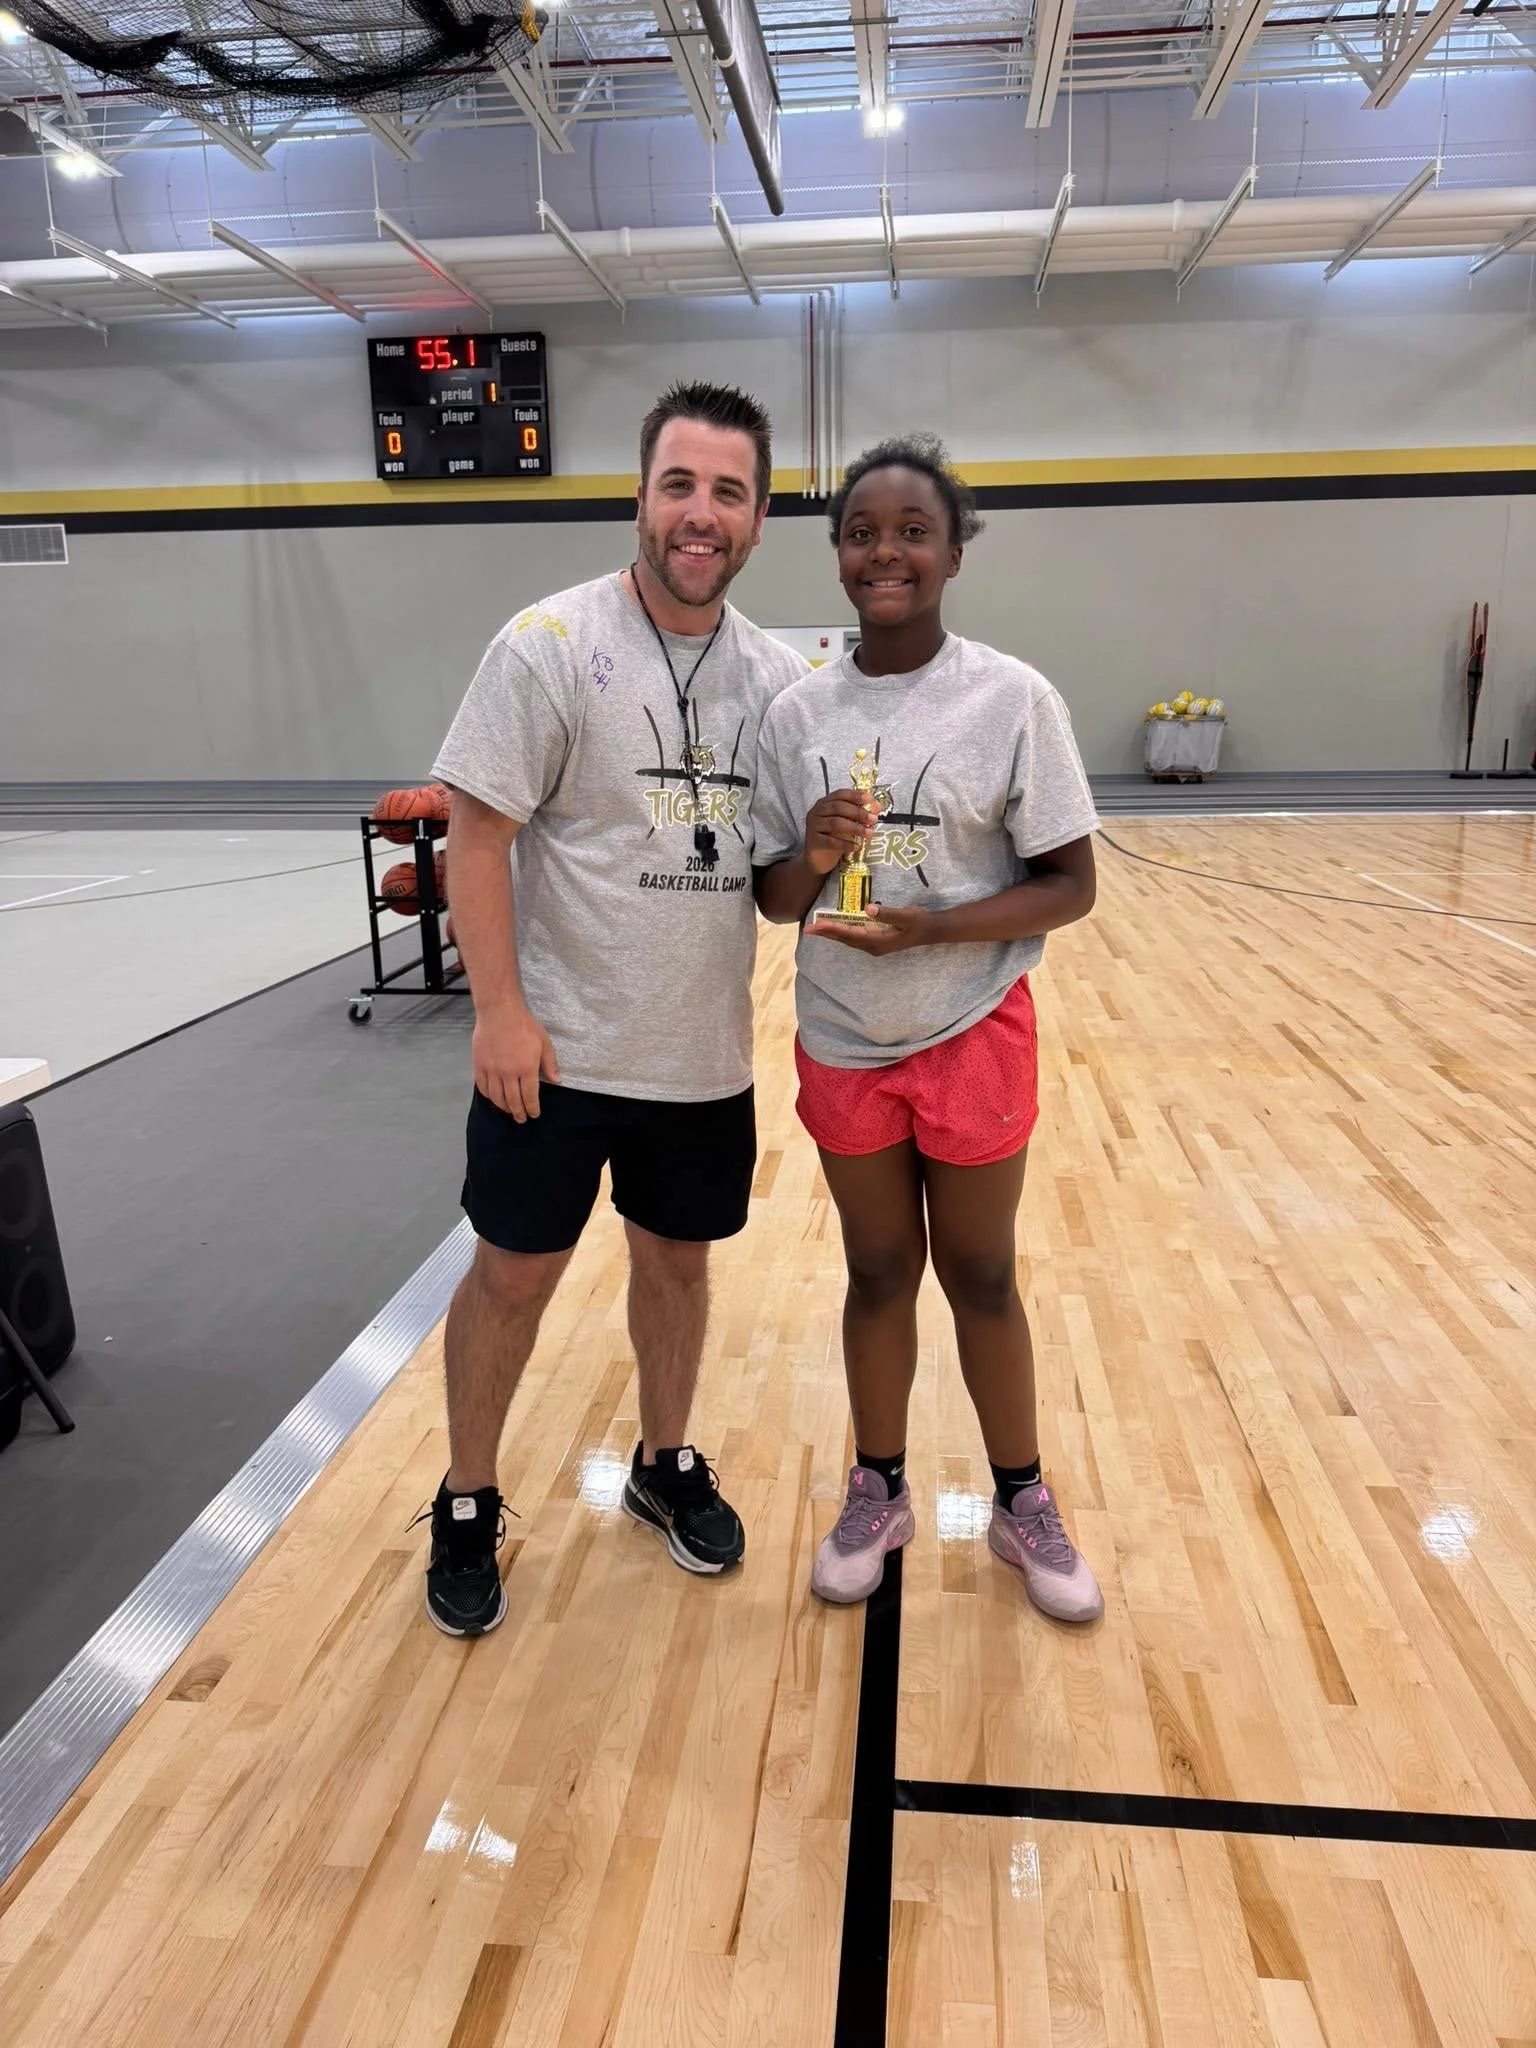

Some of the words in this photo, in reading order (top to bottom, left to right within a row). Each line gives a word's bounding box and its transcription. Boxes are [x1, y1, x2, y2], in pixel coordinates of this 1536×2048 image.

[376, 343, 405, 357] Home
[501, 338, 537, 352] Guests
[441, 387, 473, 403] period
[489, 382, 497, 402] 1
[379, 413, 403, 426] fouls
[442, 409, 475, 425] player
[514, 409, 539, 421] fouls
[387, 432, 402, 455] 0
[523, 427, 538, 451] 0
[384, 462, 404, 473] won
[448, 459, 475, 473] game
[519, 458, 540, 469] won
[643, 788, 741, 829] TIGERS
[863, 829, 930, 871] ERS
[638, 872, 719, 892] BASKETBALL
[722, 876, 746, 893] CAMP
